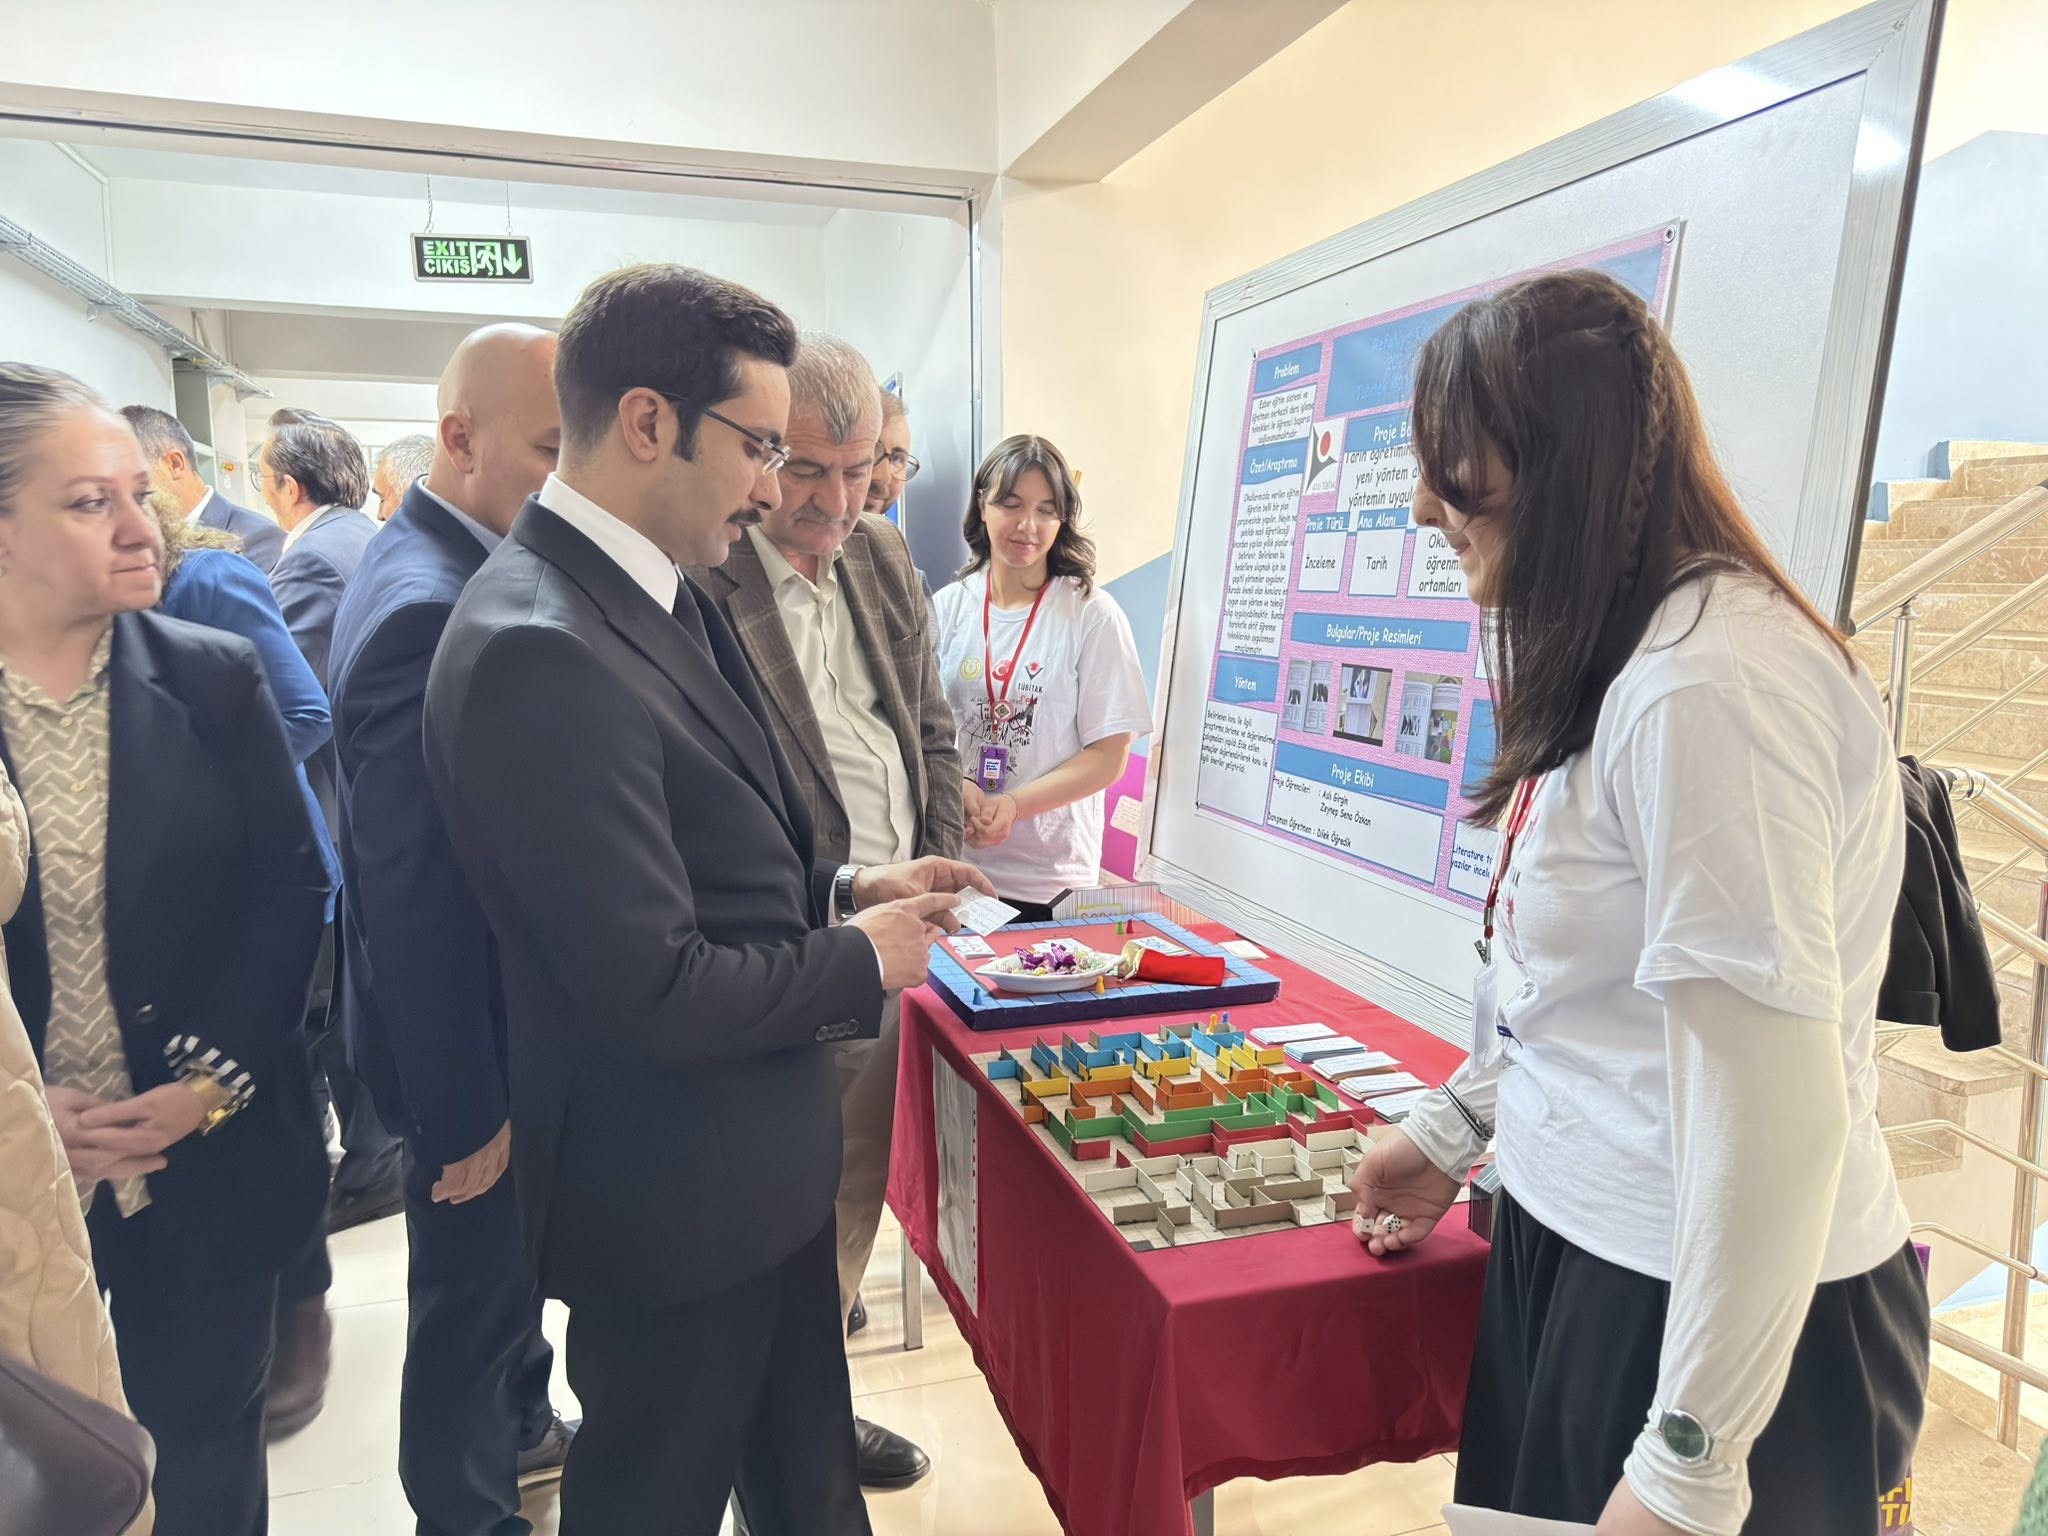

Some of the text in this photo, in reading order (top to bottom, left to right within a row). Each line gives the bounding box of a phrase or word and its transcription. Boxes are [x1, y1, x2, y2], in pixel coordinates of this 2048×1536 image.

[422, 240, 468, 256] EXIT
[1274, 362, 1300, 380] Problem
[1373, 421, 1412, 445] Proje Ba
[1250, 458, 1298, 474] Özet/Araştırma
[1355, 469, 1374, 489] yeni
[1375, 467, 1409, 487] yöntem
[1348, 490, 1386, 512] yöntemin
[1305, 516, 1344, 531] Proje Türü
[1358, 512, 1397, 529] Ana Alanı
[1305, 554, 1336, 570] İnceleme
[1366, 556, 1388, 571] Tarih
[1426, 556, 1461, 575] öğrenm
[1418, 577, 1462, 593] ortamları
[1326, 623, 1423, 646] Bulgular/Proje Resimleri
[1234, 675, 1257, 692] Yöntem
[1331, 763, 1375, 788] Proje Ekibi
[1320, 803, 1372, 827] Zeynep Sena Özkan
[1452, 844, 1485, 863] Literature
[1450, 860, 1490, 879] yazılar incel
